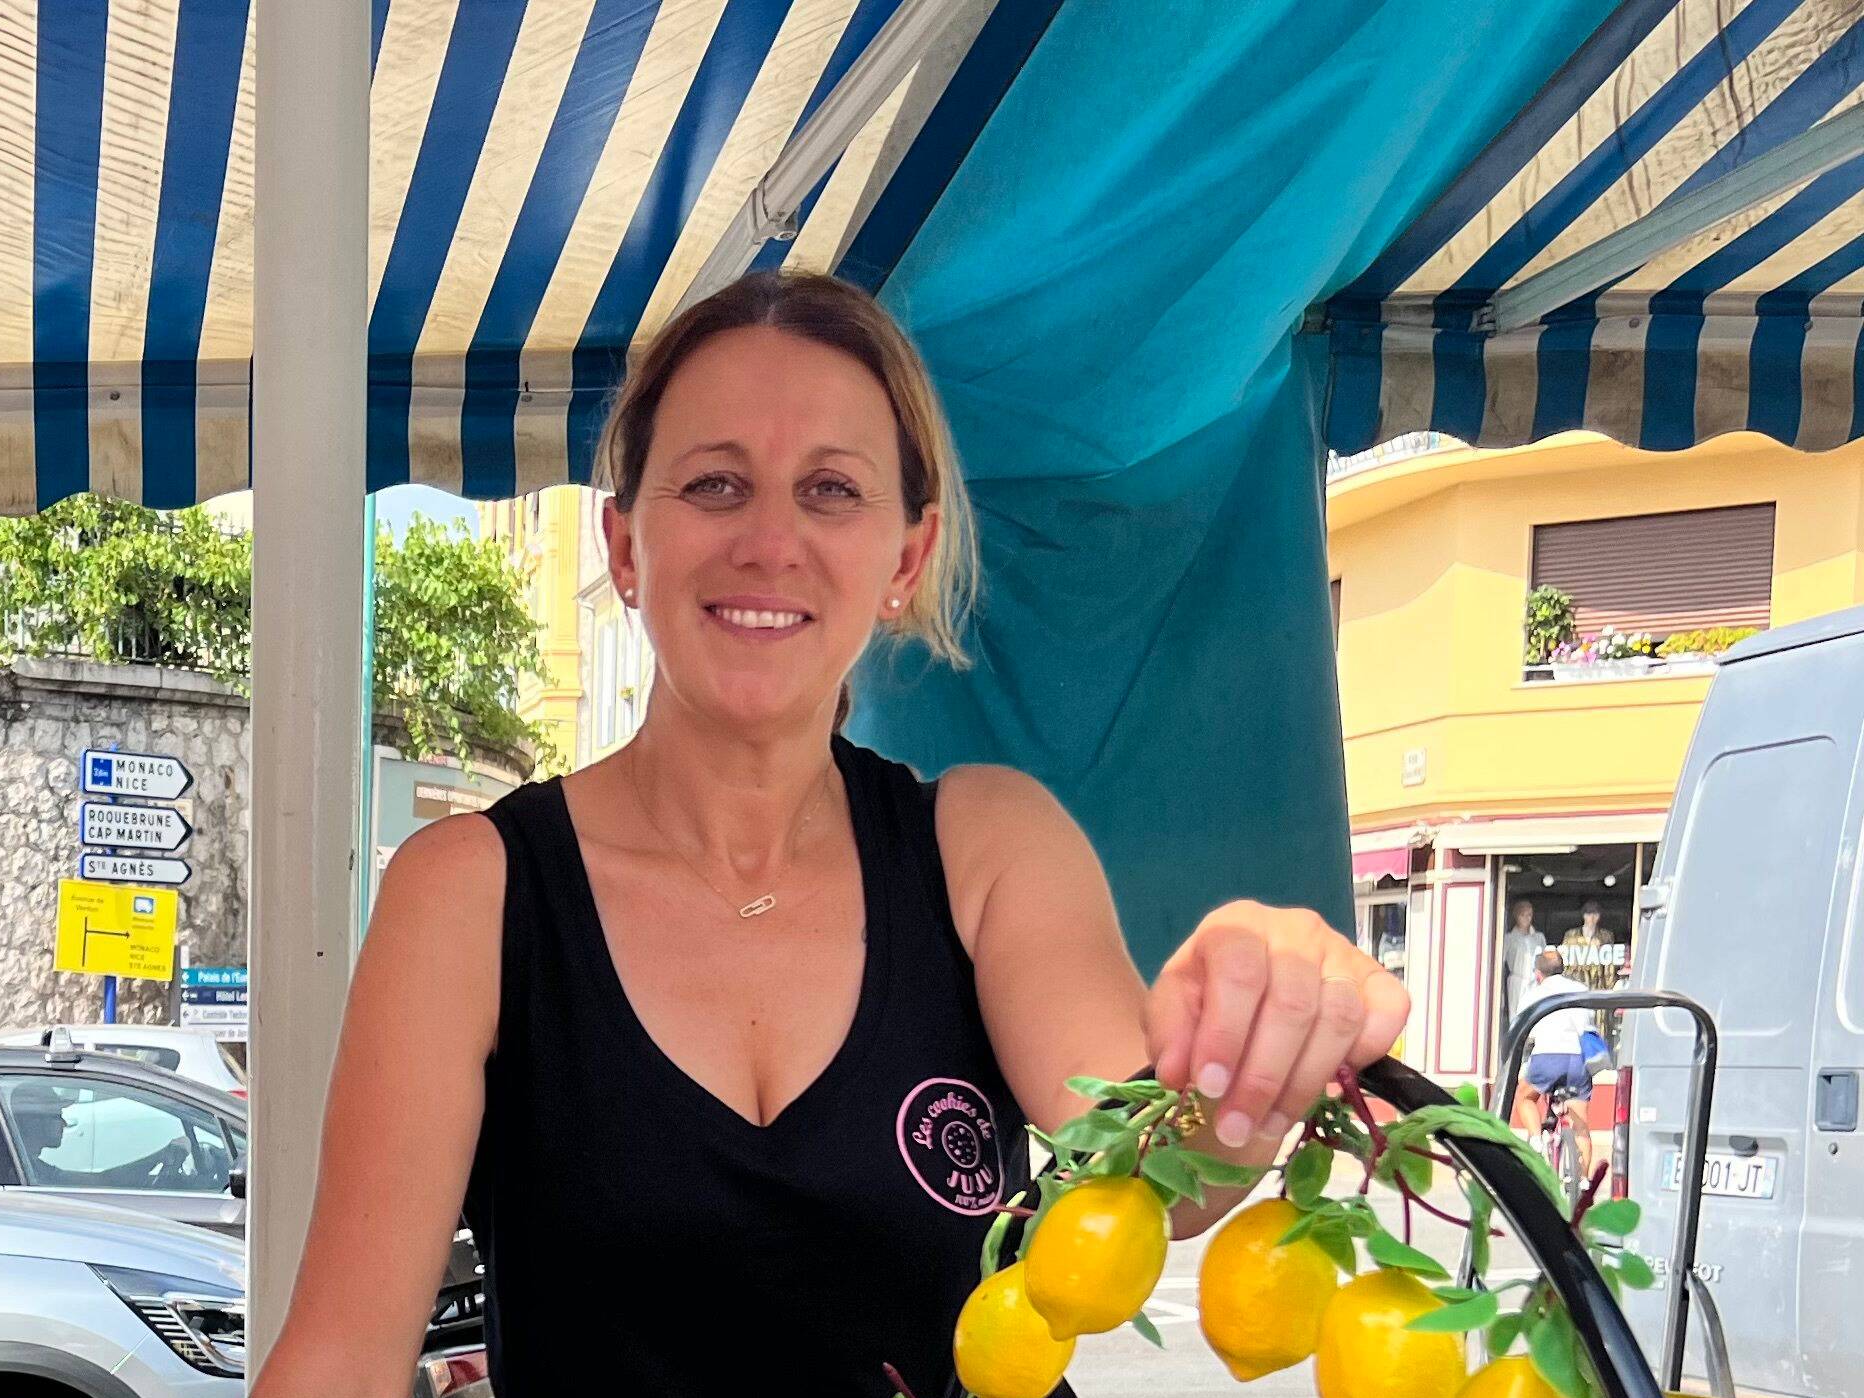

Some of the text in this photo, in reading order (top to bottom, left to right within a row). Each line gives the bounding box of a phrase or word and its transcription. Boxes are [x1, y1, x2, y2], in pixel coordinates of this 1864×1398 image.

[116, 759, 173, 777] MONACO
[116, 776, 148, 791] NICE
[88, 809, 172, 828] ROQUEBRUNE
[88, 826, 162, 843] CAP MARTIN
[927, 1091, 978, 1119] cookies
[946, 1163, 995, 1195] JUJU
